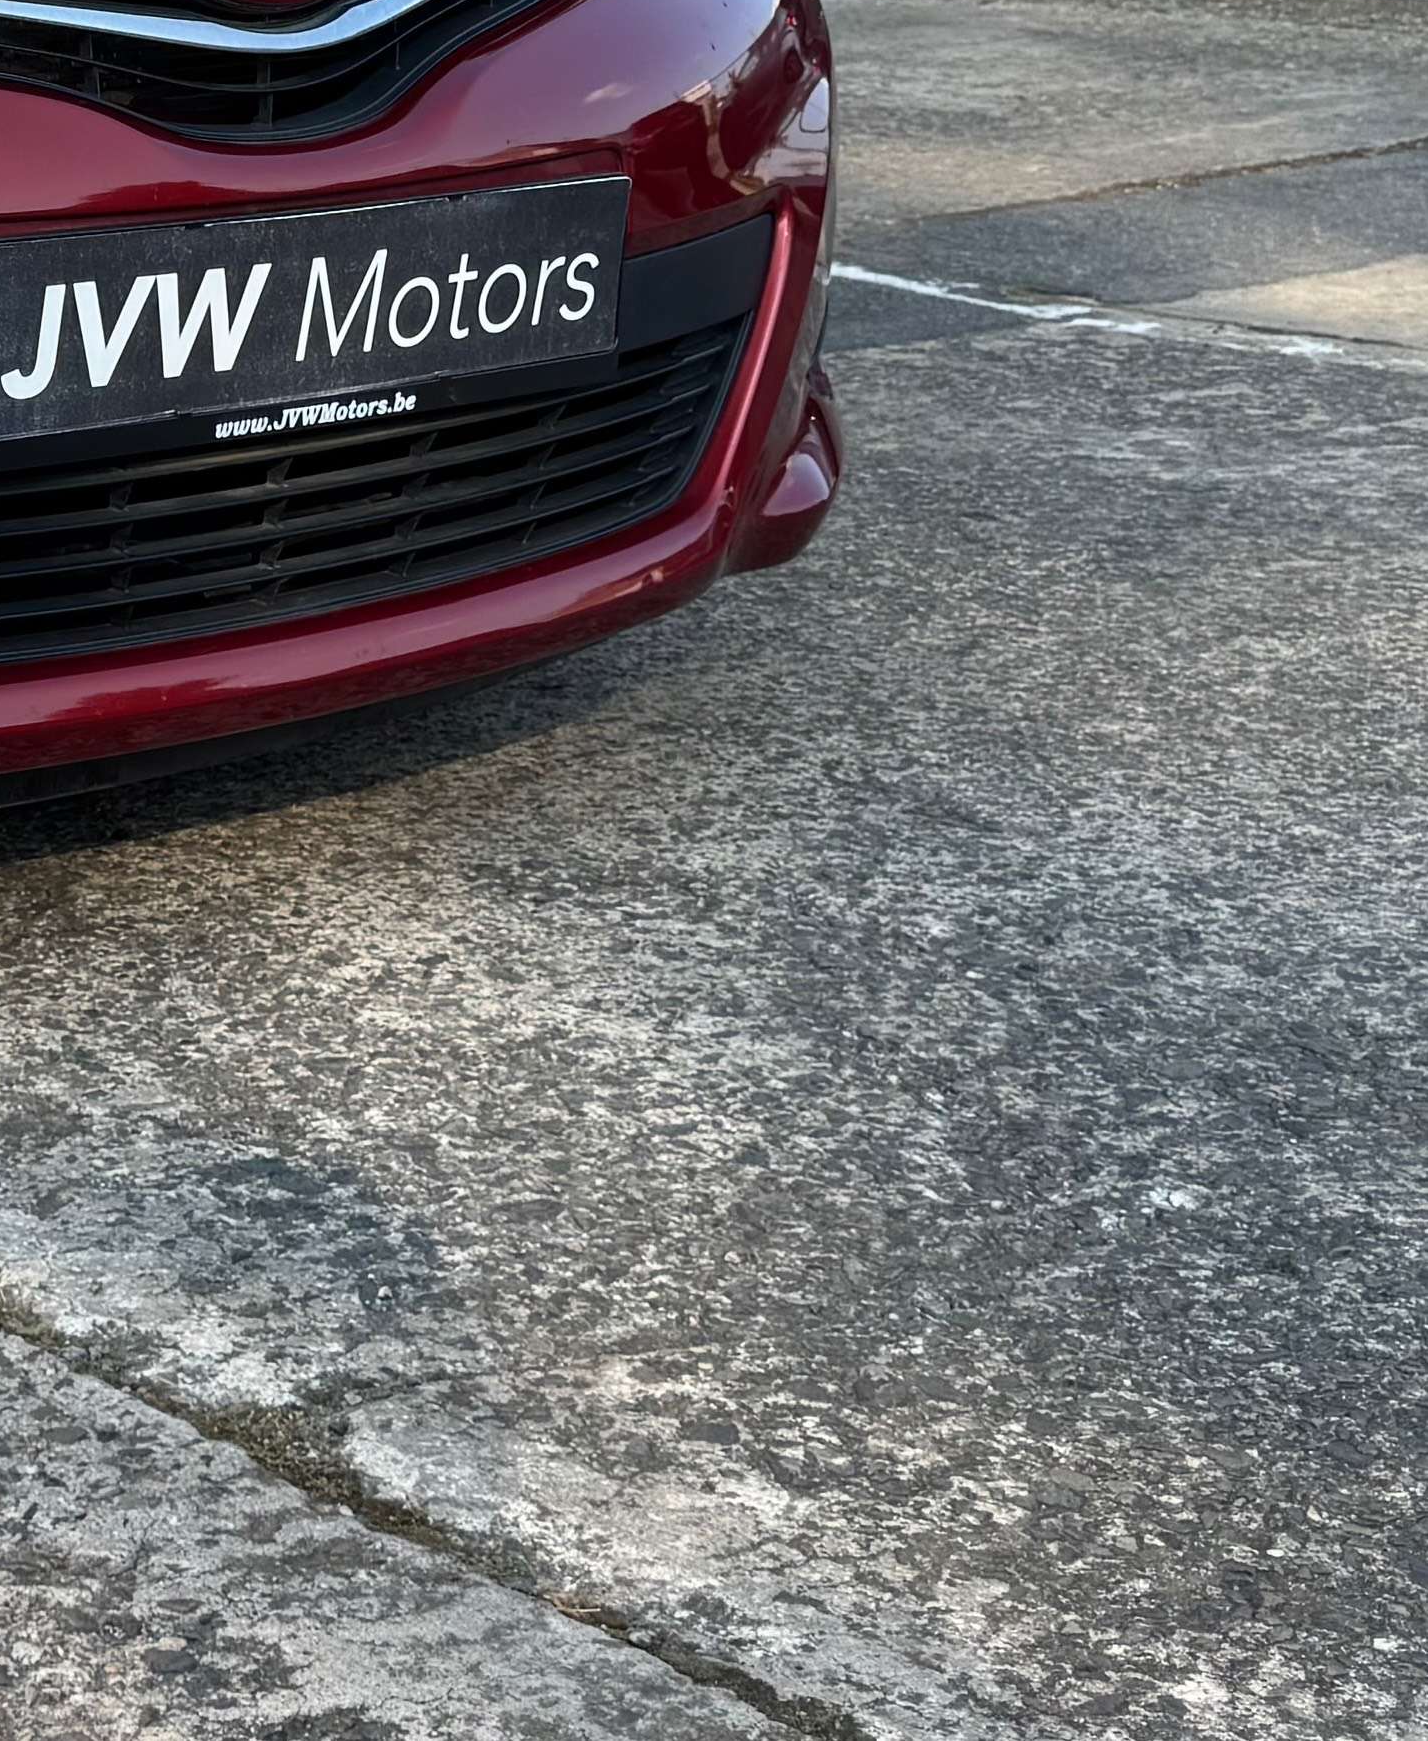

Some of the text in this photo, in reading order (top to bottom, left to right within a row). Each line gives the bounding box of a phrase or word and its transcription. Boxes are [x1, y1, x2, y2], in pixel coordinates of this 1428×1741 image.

[0, 248, 600, 400] JVW Motors
[215, 391, 417, 439] www.JVWMotors.be
